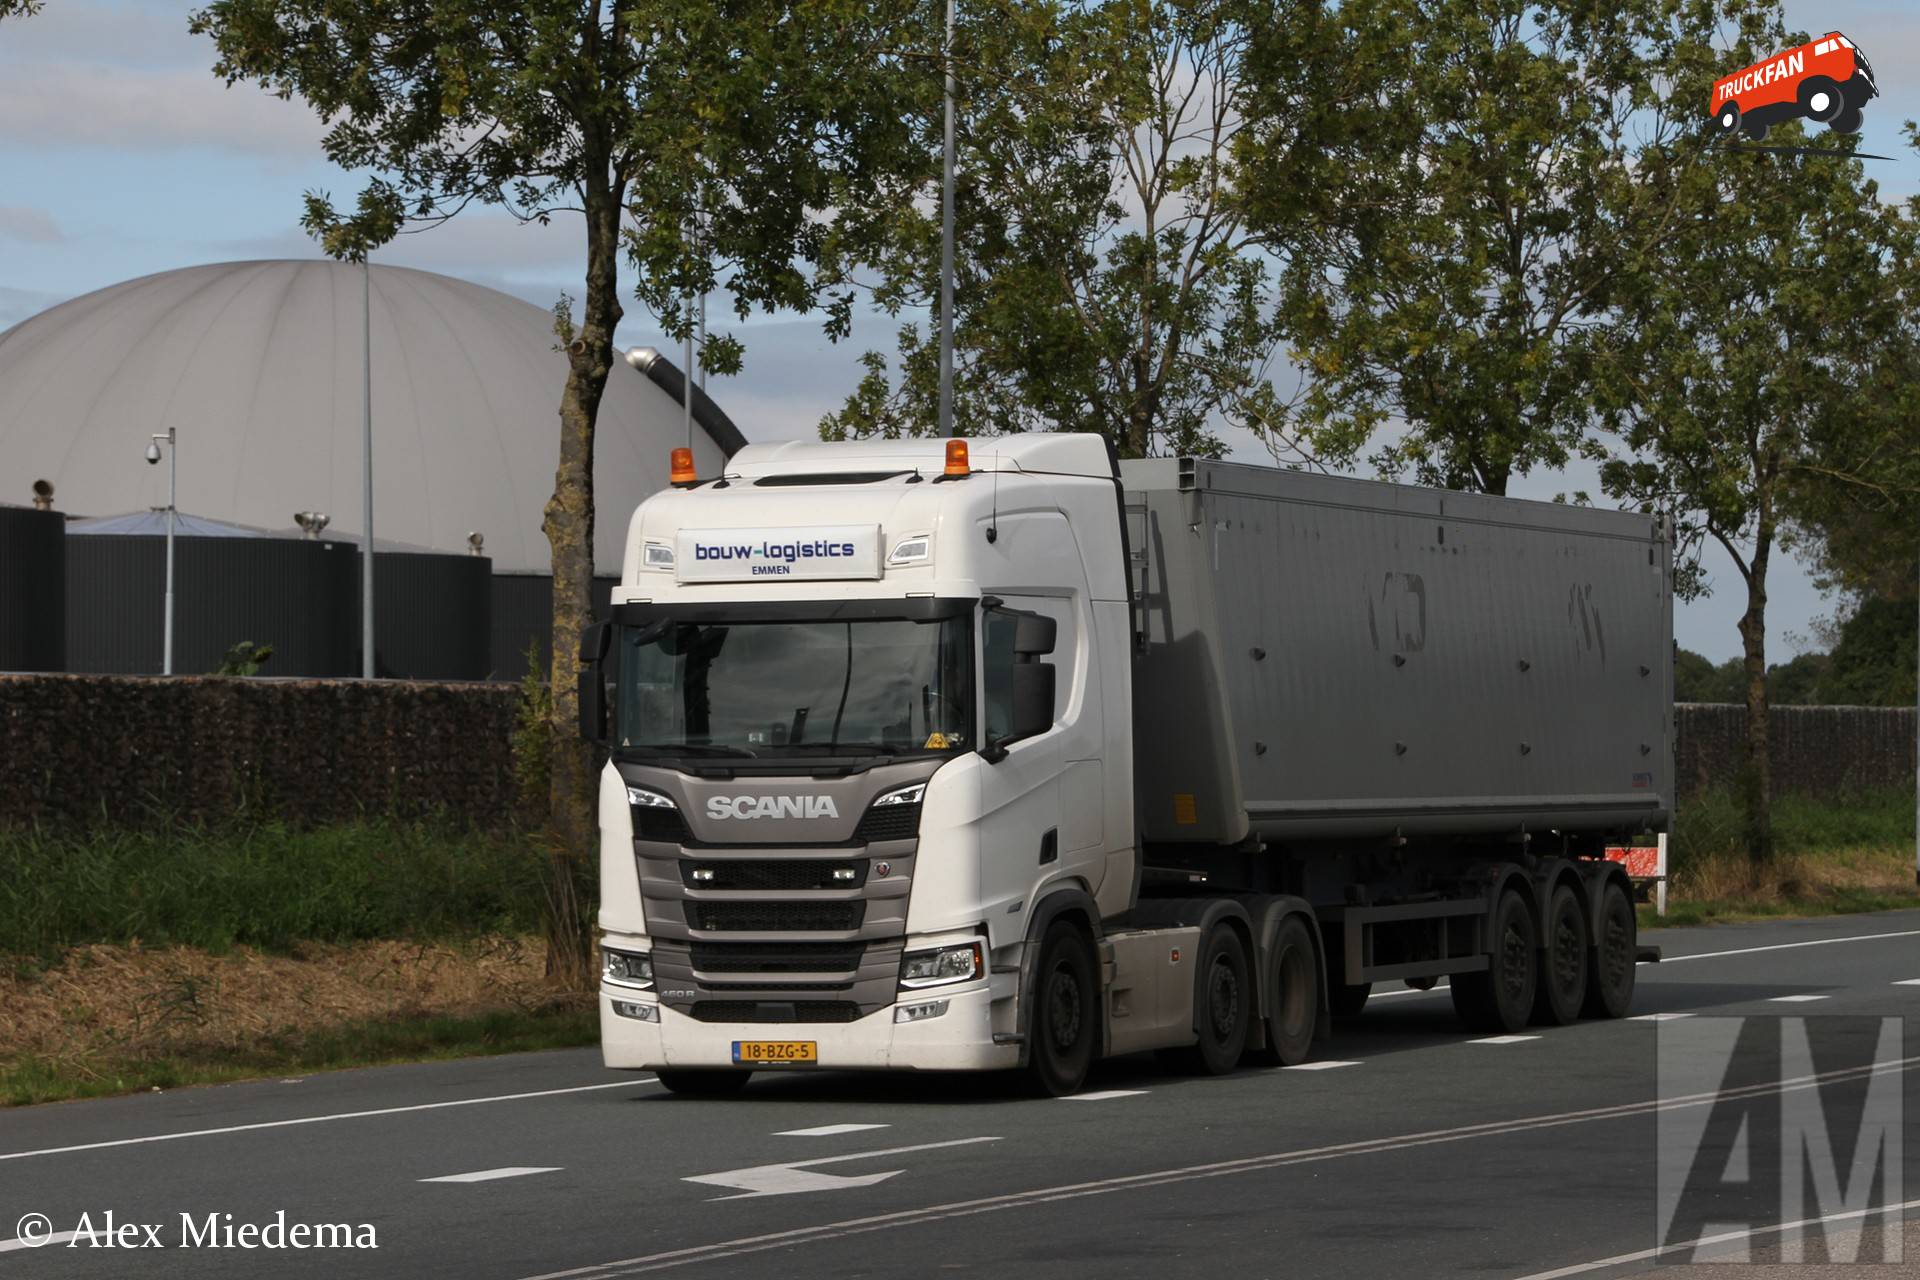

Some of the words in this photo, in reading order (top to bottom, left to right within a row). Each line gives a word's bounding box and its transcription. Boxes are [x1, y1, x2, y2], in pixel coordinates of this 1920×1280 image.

[695, 540, 855, 563] bouw-logistics
[752, 565, 790, 576] EMMEN
[706, 795, 839, 819] SCANIA
[746, 1044, 809, 1058] 18-BZG-5
